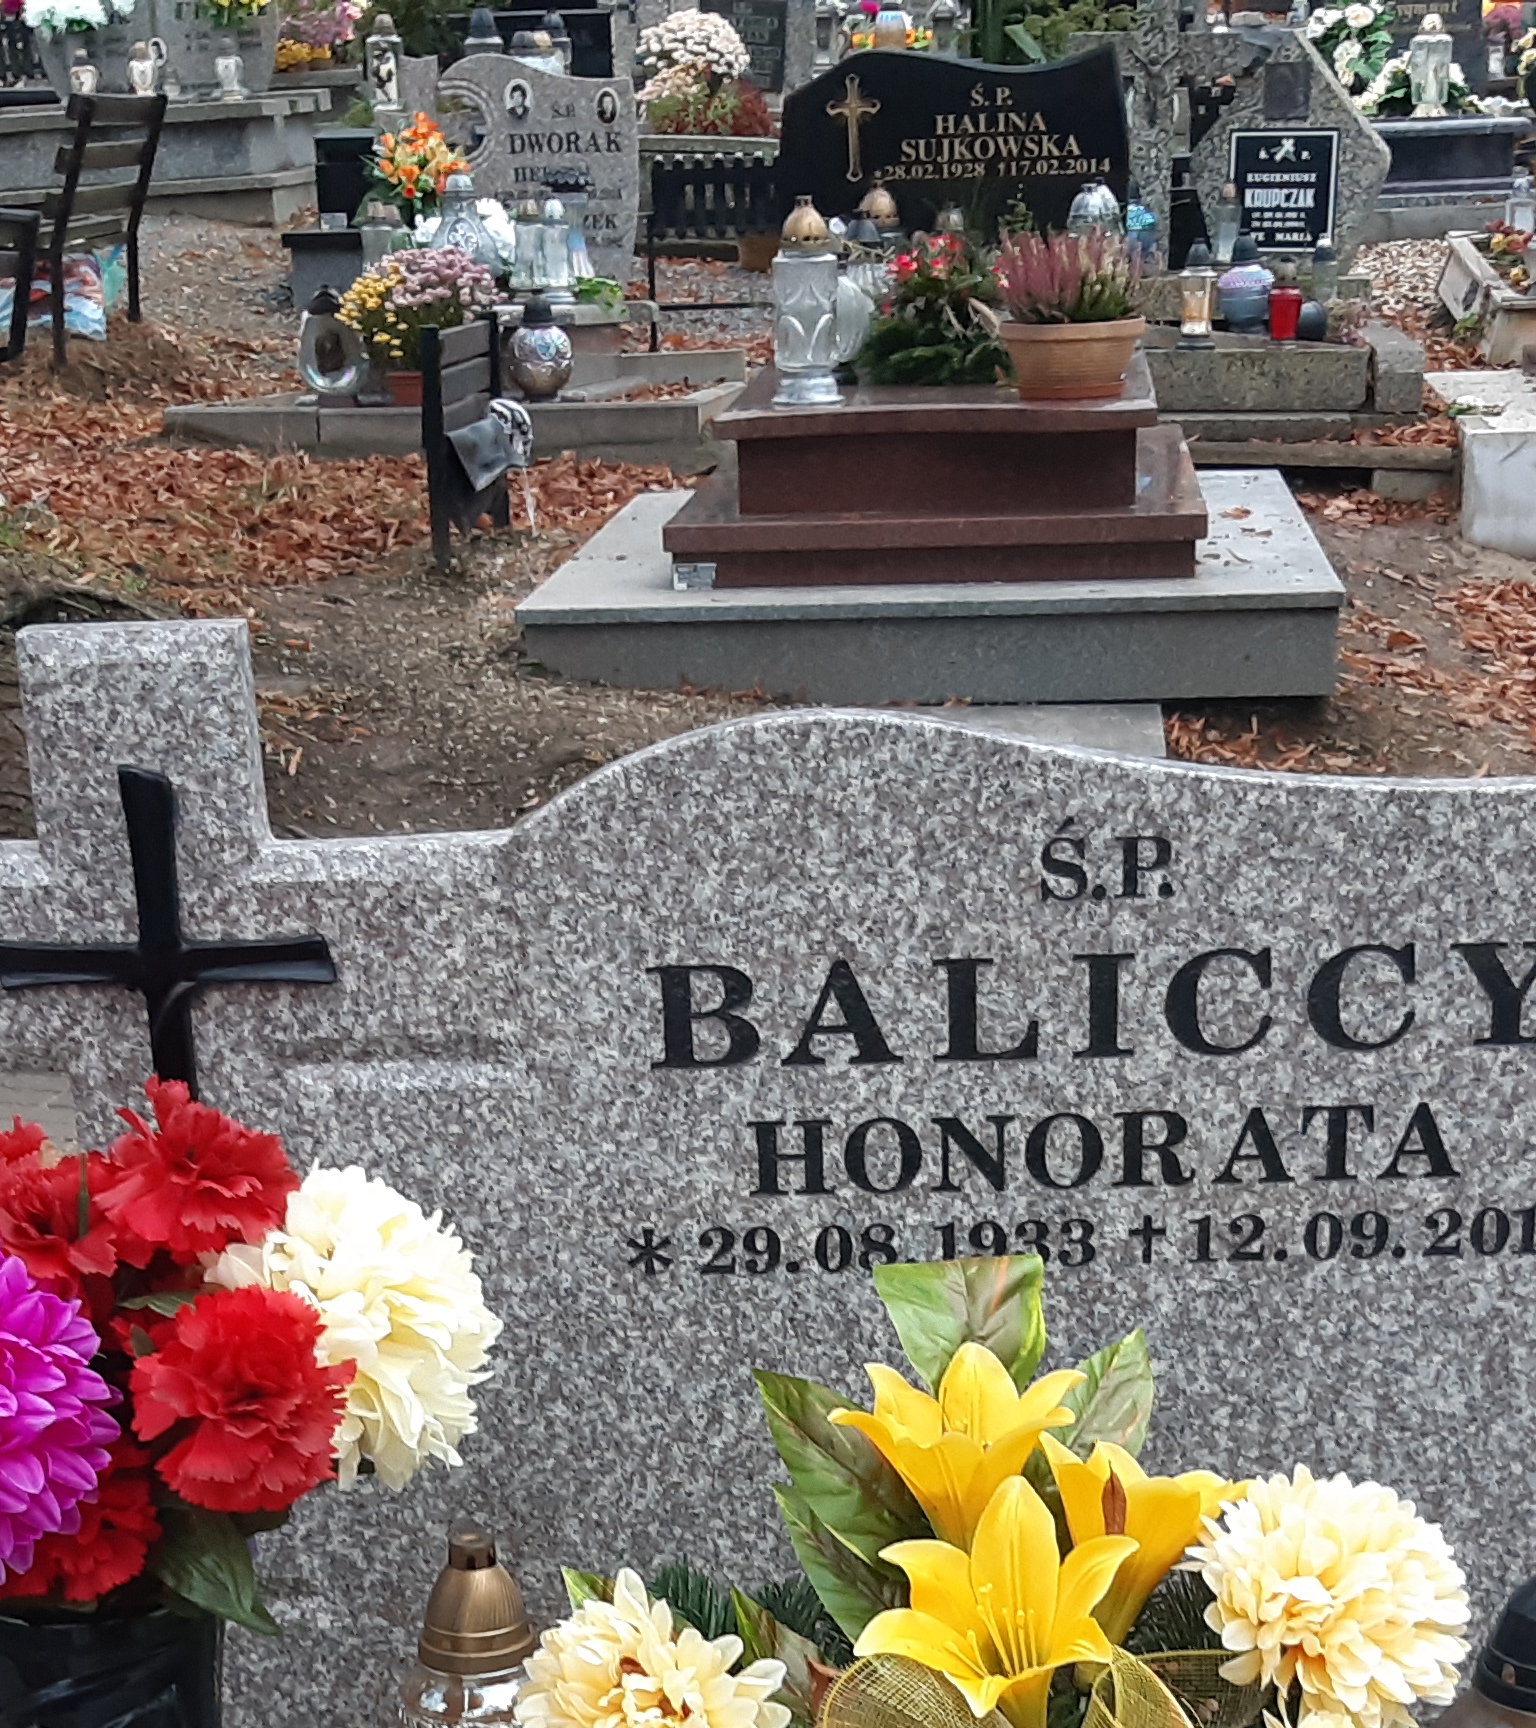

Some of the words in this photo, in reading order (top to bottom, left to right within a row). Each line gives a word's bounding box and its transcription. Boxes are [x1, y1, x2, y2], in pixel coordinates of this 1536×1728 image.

[934, 111, 1048, 136] HALINA
[507, 130, 623, 155] DWORAK
[900, 133, 1082, 163] SUJKOWSKA
[1038, 818, 1175, 903] Ś.P.
[747, 1102, 1462, 1199] HONORATA
